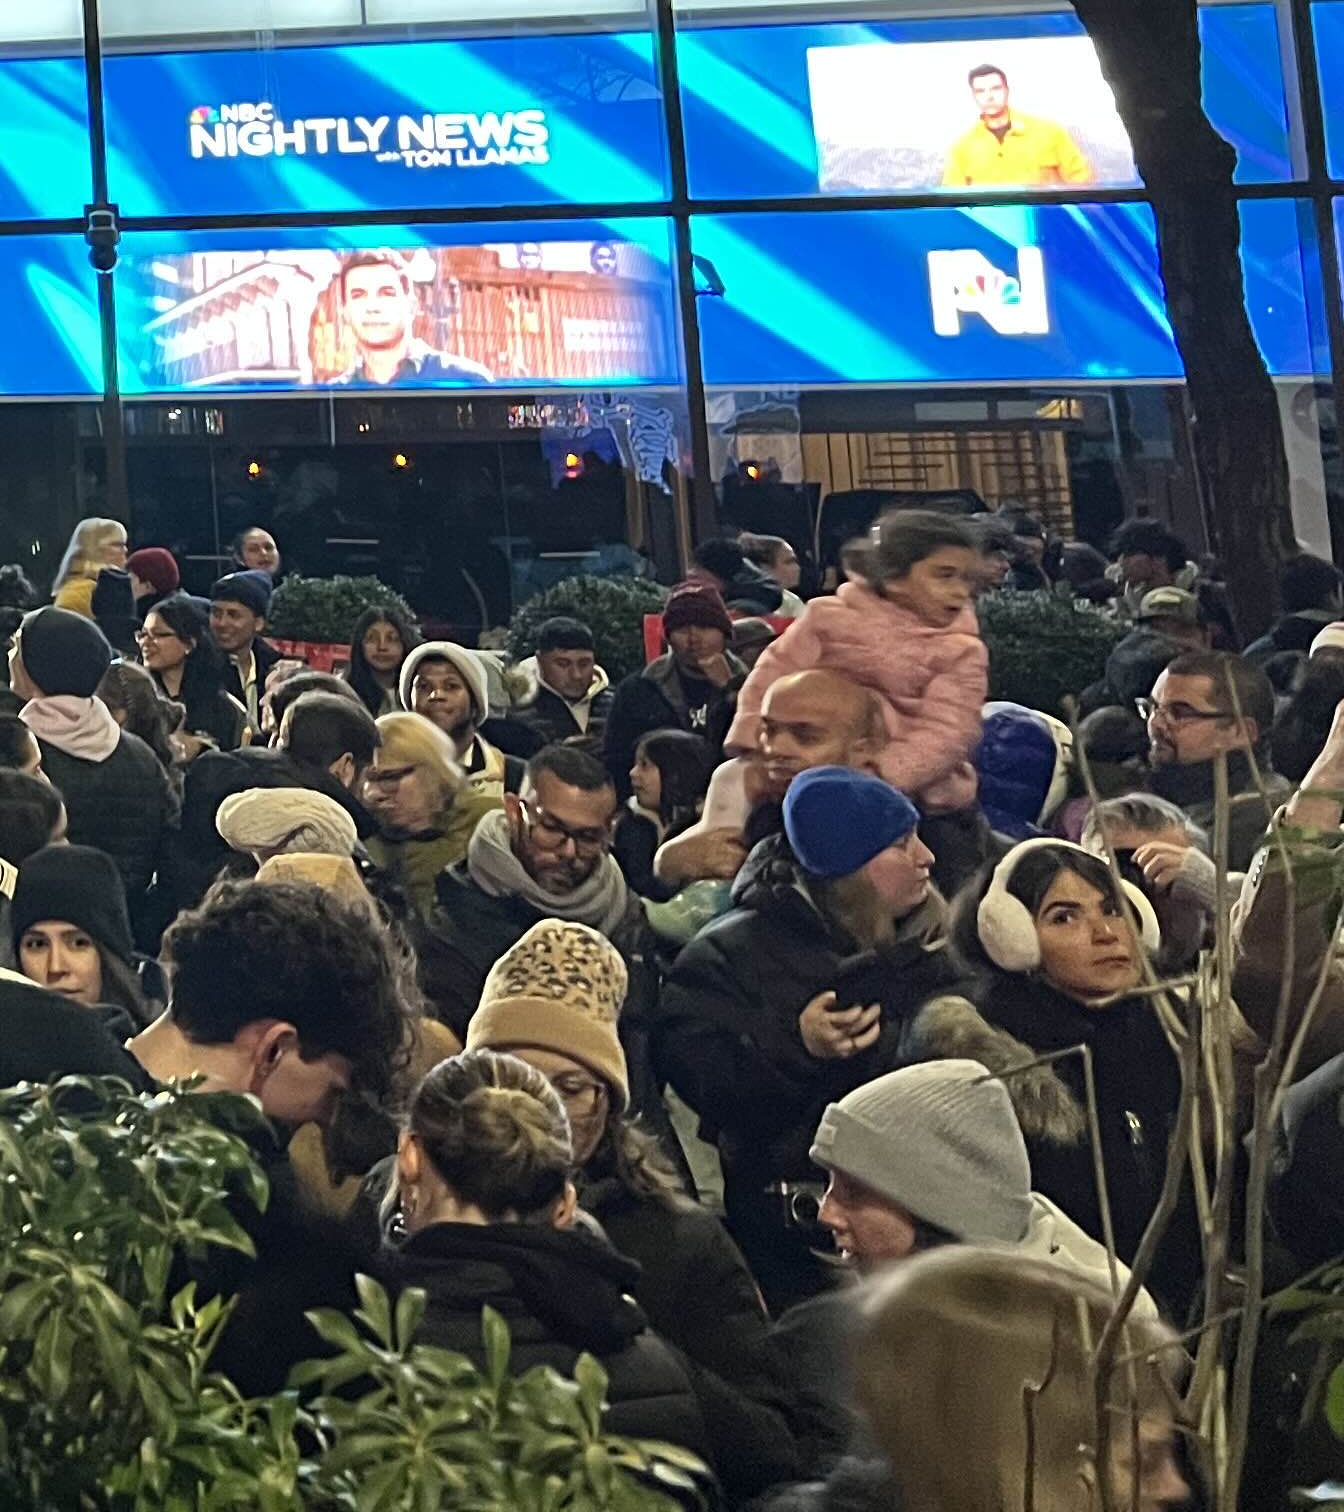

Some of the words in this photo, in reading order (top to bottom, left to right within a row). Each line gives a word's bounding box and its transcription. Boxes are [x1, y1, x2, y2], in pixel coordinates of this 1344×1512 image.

[220, 102, 274, 123] NBC
[190, 115, 389, 159] NIGHTLY
[397, 109, 549, 151] NEWS
[400, 149, 452, 169] TOM
[456, 145, 550, 168] LLAMAS
